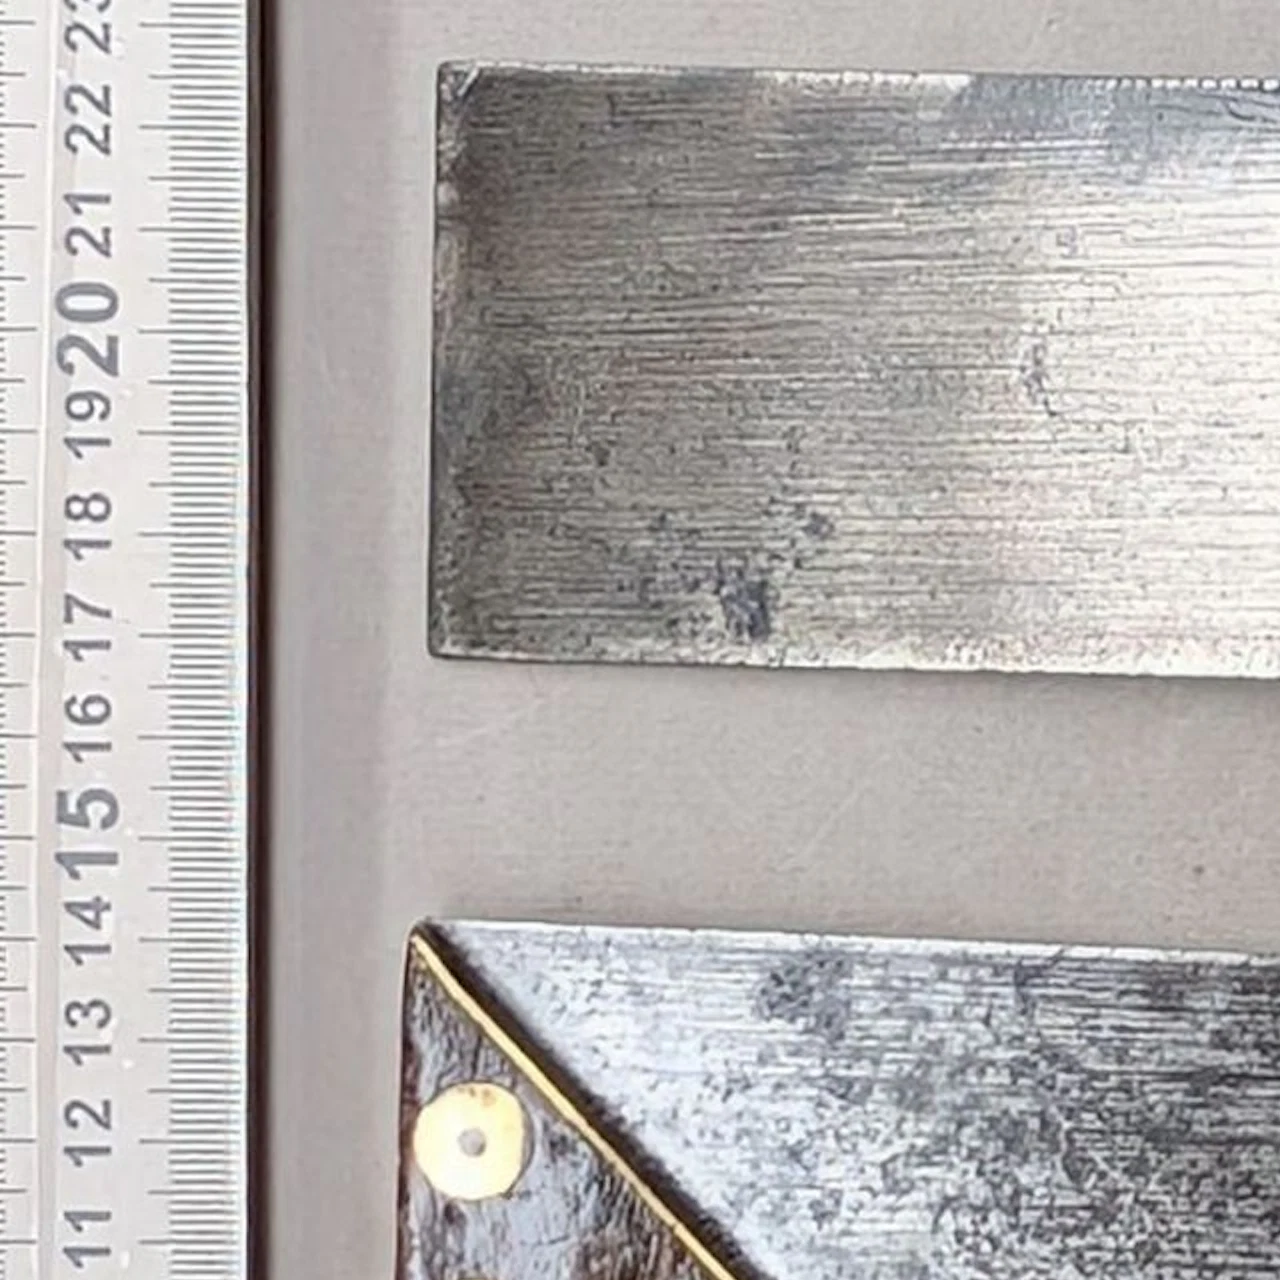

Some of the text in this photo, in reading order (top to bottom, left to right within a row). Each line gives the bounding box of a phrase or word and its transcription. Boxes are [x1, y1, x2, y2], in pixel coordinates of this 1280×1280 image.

[62, 83, 113, 158] 22
[62, 191, 113, 260] 21
[54, 281, 120, 380] 20
[62, 389, 113, 460] 19
[62, 491, 113, 562] 18
[62, 592, 113, 663] 17
[62, 693, 113, 764] 16
[54, 787, 120, 881] 15
[62, 895, 113, 967] 14
[62, 998, 113, 1067] 13
[62, 1098, 113, 1169] 12
[62, 1210, 113, 1270] 11
